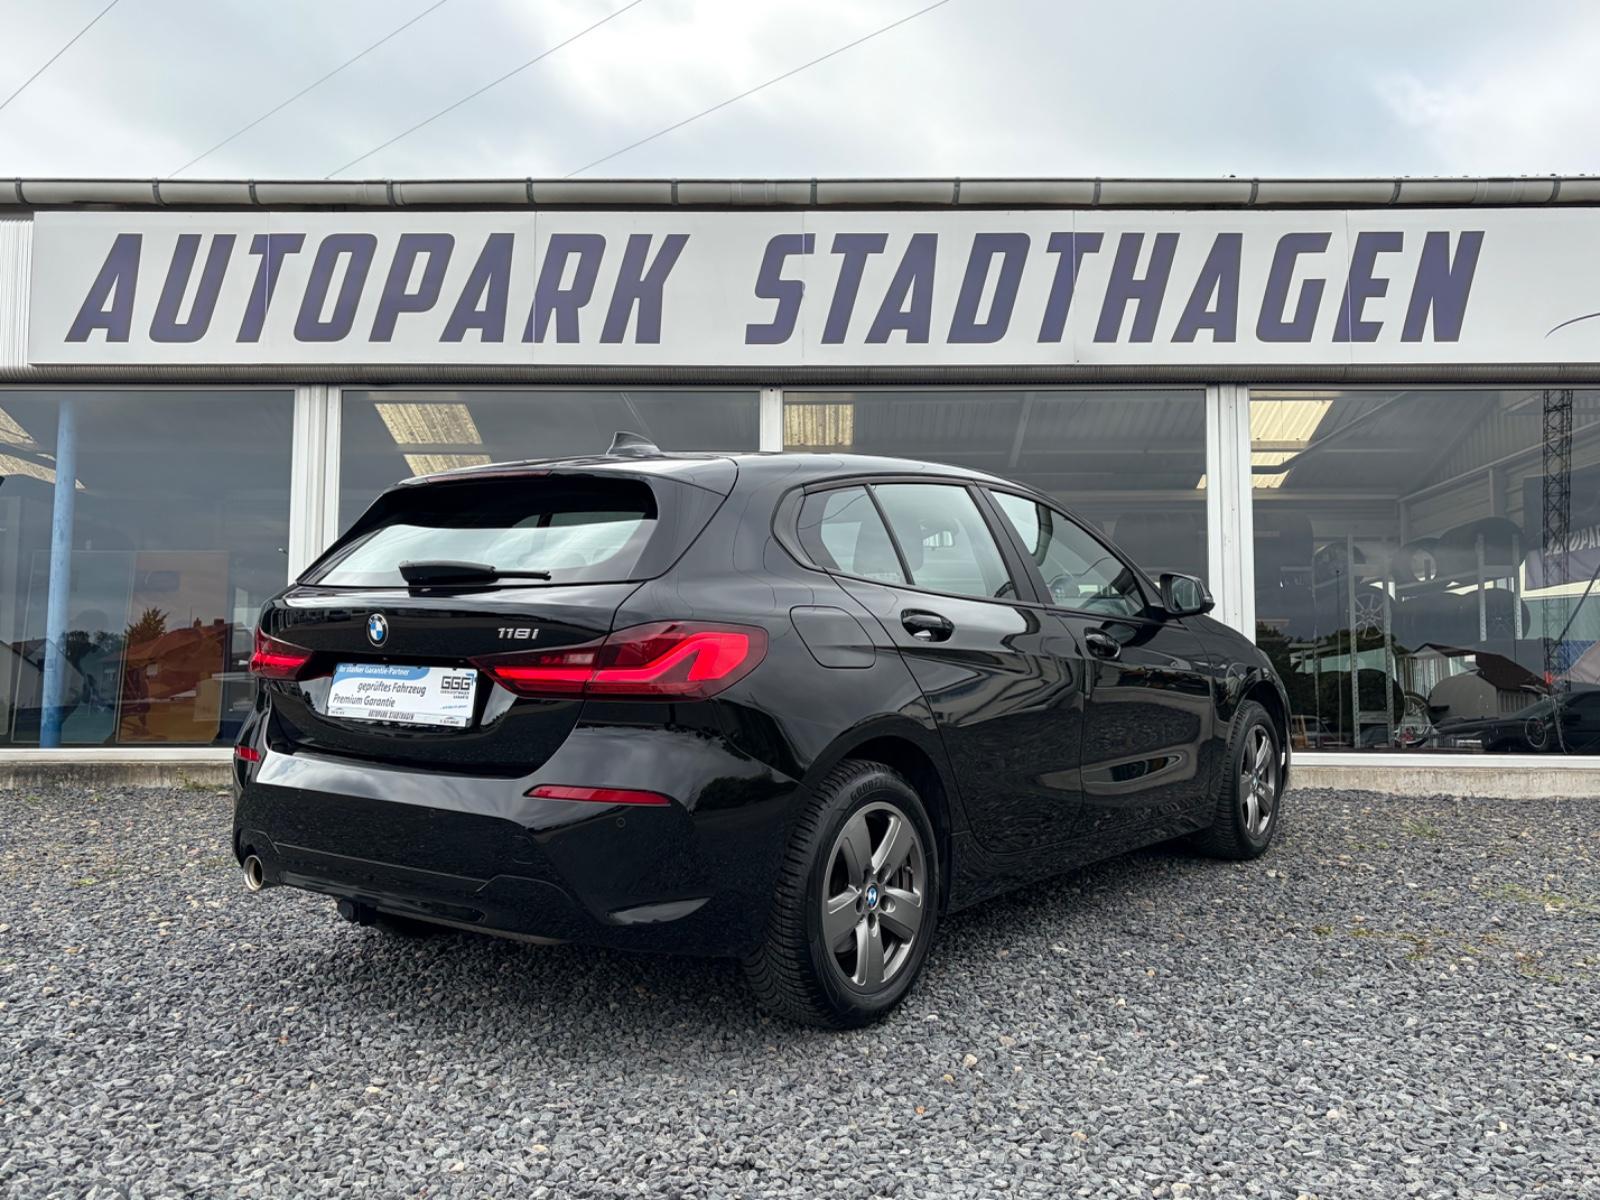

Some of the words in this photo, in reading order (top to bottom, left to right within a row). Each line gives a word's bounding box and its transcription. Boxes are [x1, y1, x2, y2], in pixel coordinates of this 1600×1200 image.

[65, 233, 690, 344] AUTOPARK
[745, 231, 1486, 345] STADTHAGEN
[498, 628, 539, 639] 118i
[357, 681, 391, 693] geprüftes
[391, 684, 427, 697] Fahrzeug
[441, 675, 471, 690] GGG
[333, 693, 363, 705] Premium
[364, 695, 396, 707] Garantie
